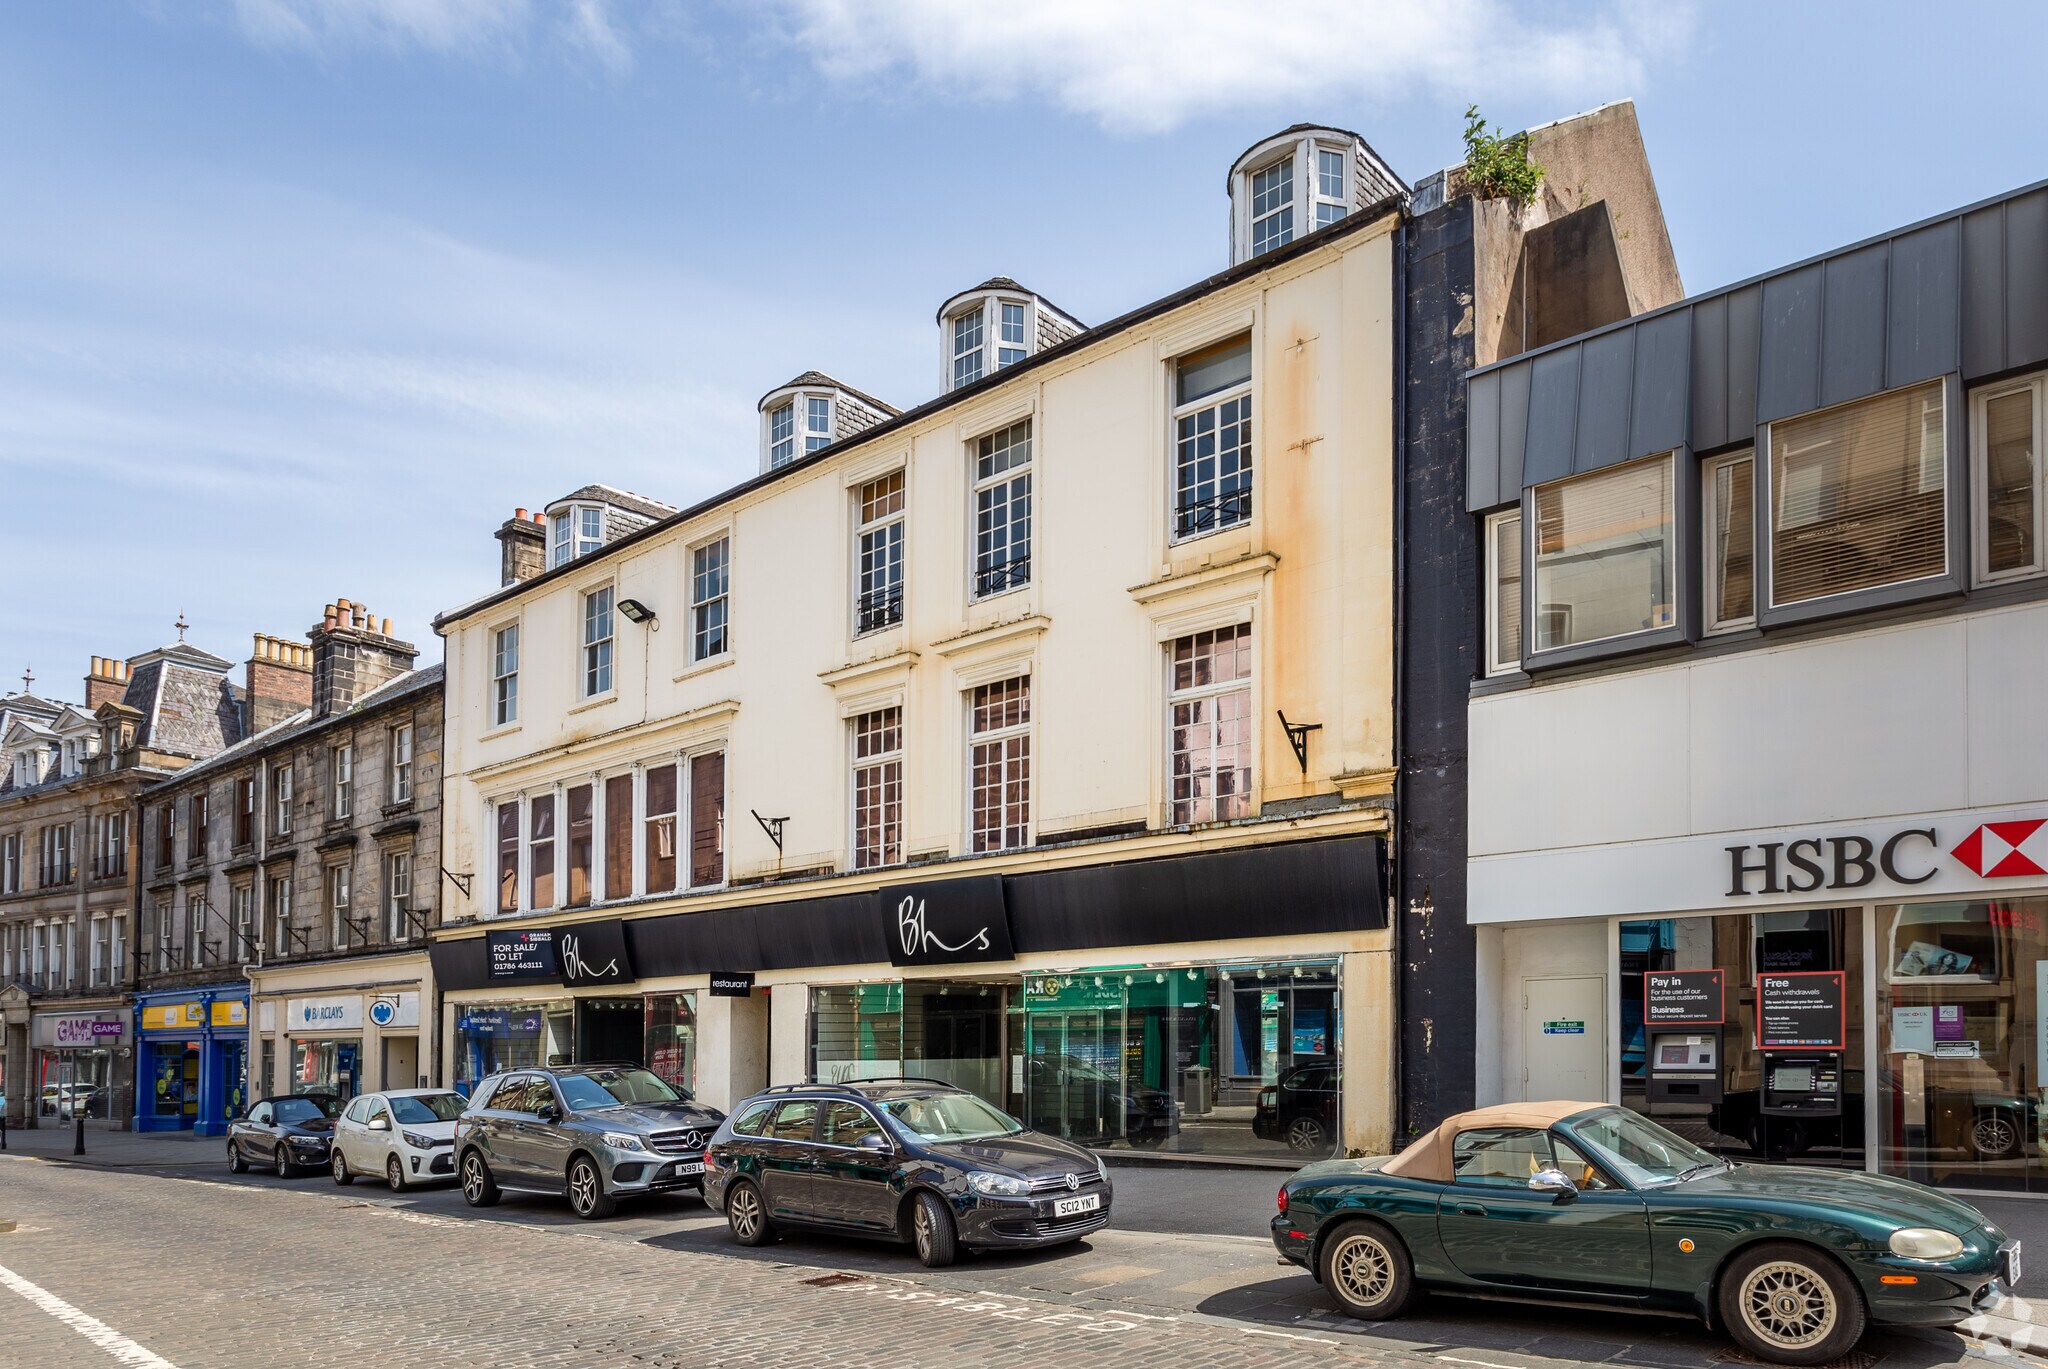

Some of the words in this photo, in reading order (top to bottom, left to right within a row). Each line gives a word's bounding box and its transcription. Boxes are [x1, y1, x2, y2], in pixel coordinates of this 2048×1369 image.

[1725, 828, 1938, 896] HSBC
[899, 895, 990, 956] Bhs
[493, 944, 511, 952] FOR
[514, 943, 537, 951] SALE/
[494, 953, 506, 961] TO
[508, 953, 523, 961] LET
[562, 934, 619, 979] Bhs
[494, 962, 516, 970] 01786
[712, 980, 748, 988] restaurant
[1651, 977, 1669, 988] Pay
[1671, 977, 1681, 986] in
[1765, 978, 1789, 988] Free
[1651, 1006, 1684, 1014] Business
[58, 1020, 92, 1041] GAME
[94, 1025, 121, 1033] GAME
[681, 1164, 696, 1174] N99
[1061, 1201, 1079, 1213] SC12
[1081, 1198, 1095, 1209] YNT
